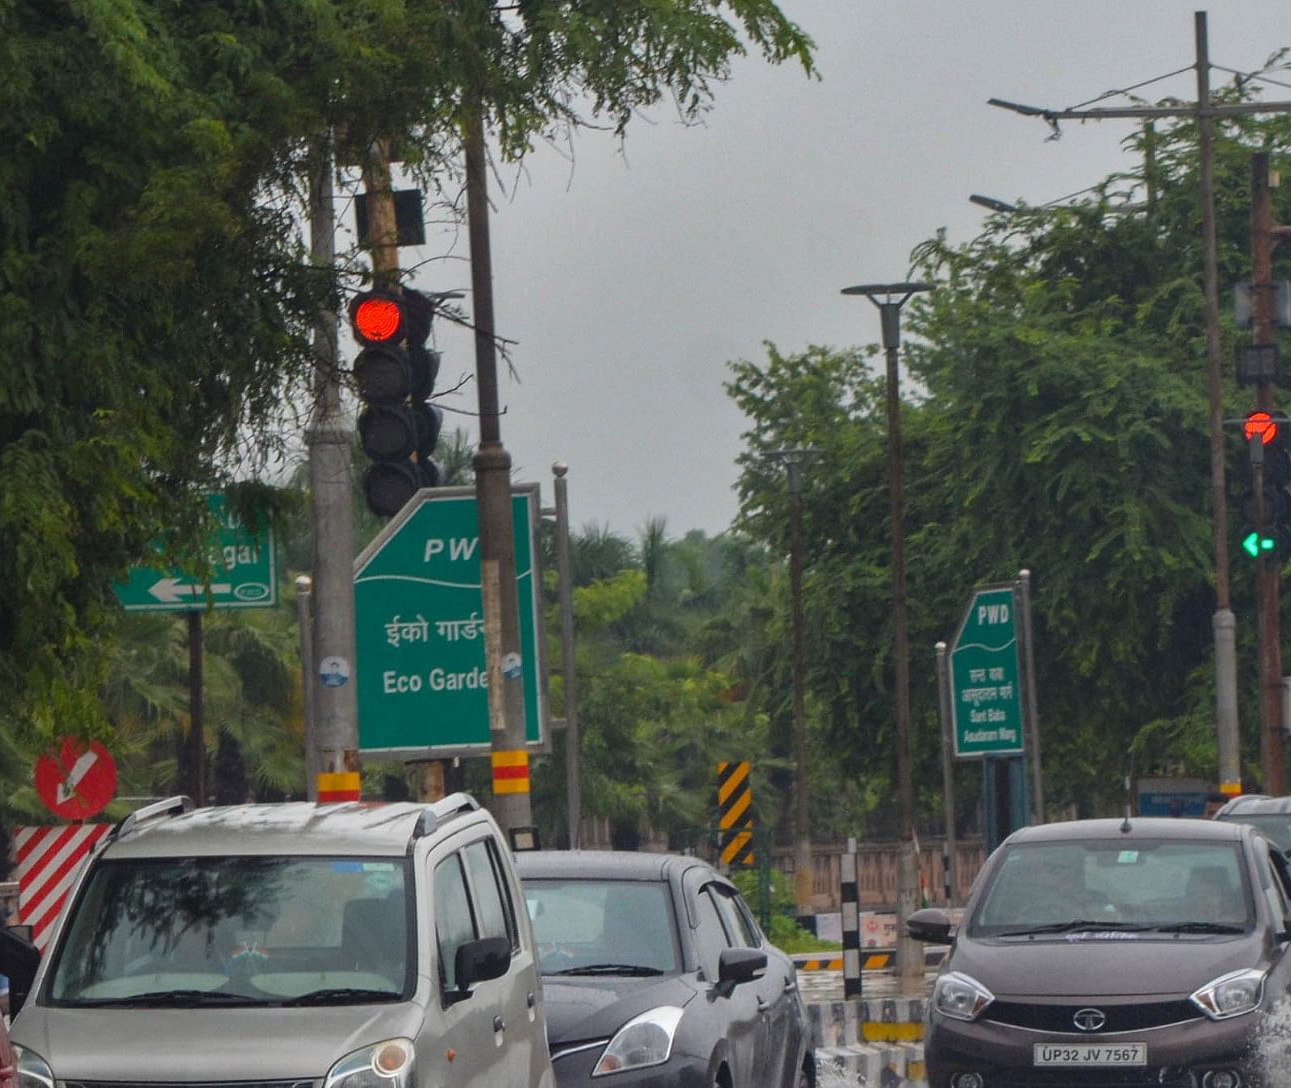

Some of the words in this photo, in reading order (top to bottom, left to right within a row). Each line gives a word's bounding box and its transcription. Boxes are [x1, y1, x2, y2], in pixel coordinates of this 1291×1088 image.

[423, 536, 479, 562] PW
[434, 611, 485, 641] गार्ड
[978, 604, 1009, 625] PWD
[383, 670, 423, 694] Eco
[429, 665, 490, 691] Garde
[1042, 1049, 1079, 1061] UP32
[1083, 1049, 1101, 1061] JV
[1105, 1049, 1139, 1061] 7567
